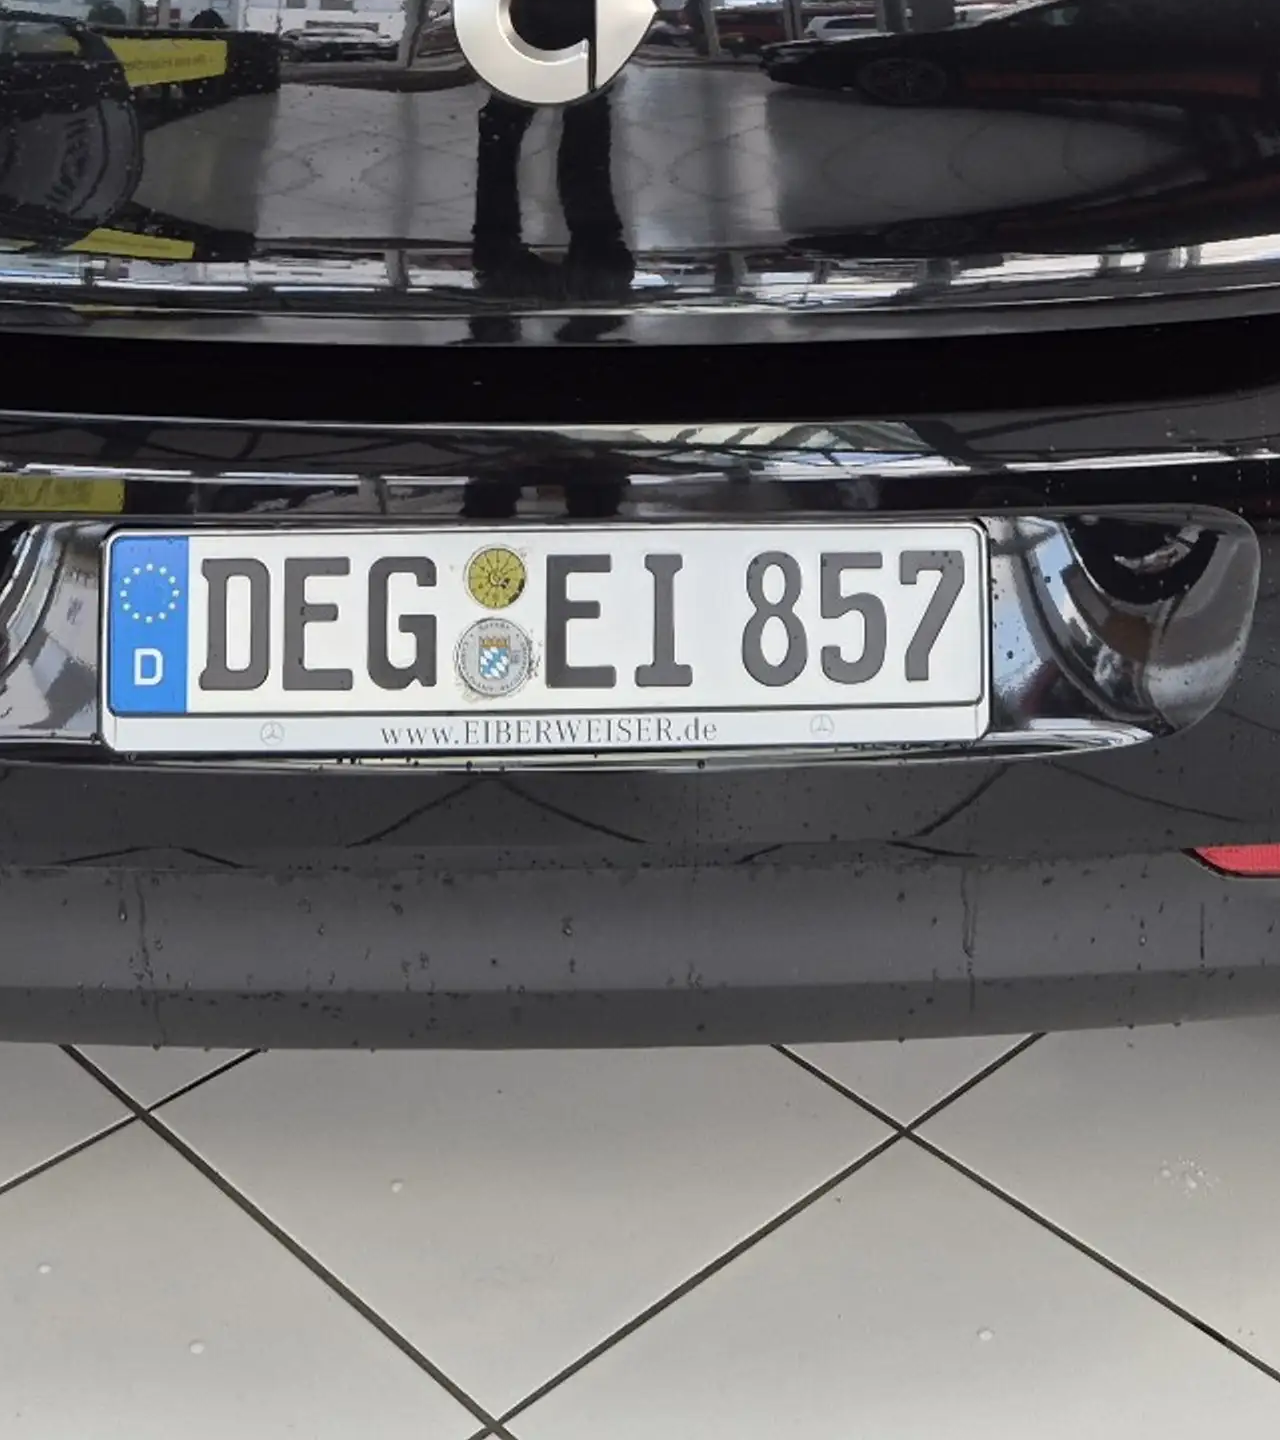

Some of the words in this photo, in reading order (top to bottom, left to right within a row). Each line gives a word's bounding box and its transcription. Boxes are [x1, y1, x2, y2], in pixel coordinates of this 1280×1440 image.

[197, 554, 438, 692] DEG
[544, 552, 695, 690] EI
[741, 549, 967, 688] 857
[132, 647, 165, 688] D
[380, 716, 719, 746] www.EIBERWEISER.de
